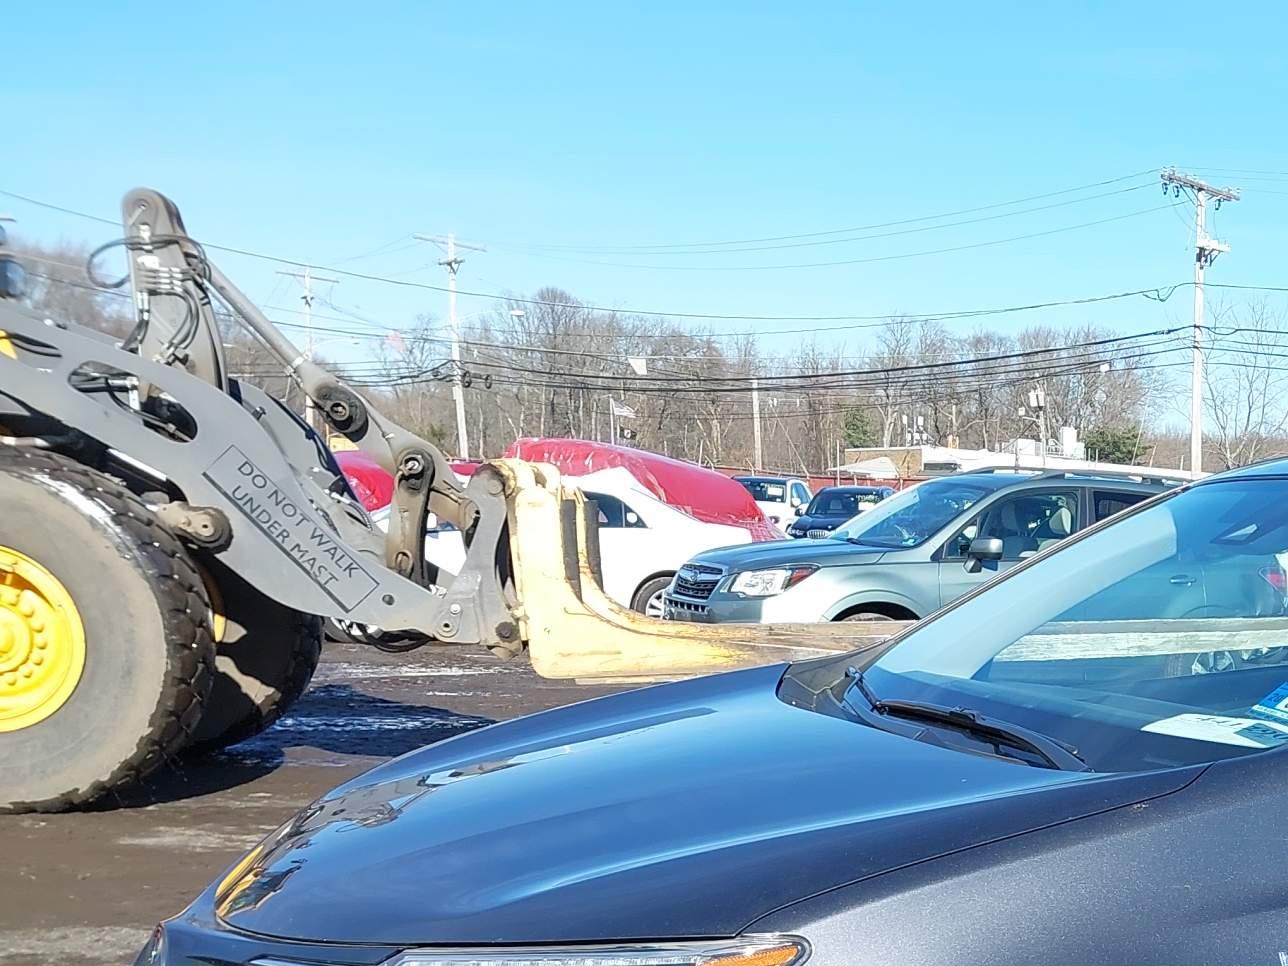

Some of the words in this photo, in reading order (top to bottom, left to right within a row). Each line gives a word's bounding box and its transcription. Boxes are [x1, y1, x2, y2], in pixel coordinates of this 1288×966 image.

[231, 485, 290, 544] UNDER
[290, 543, 339, 586] MAST
[237, 461, 267, 489] DO
[267, 490, 310, 527] NOT
[310, 527, 359, 578] WALK
